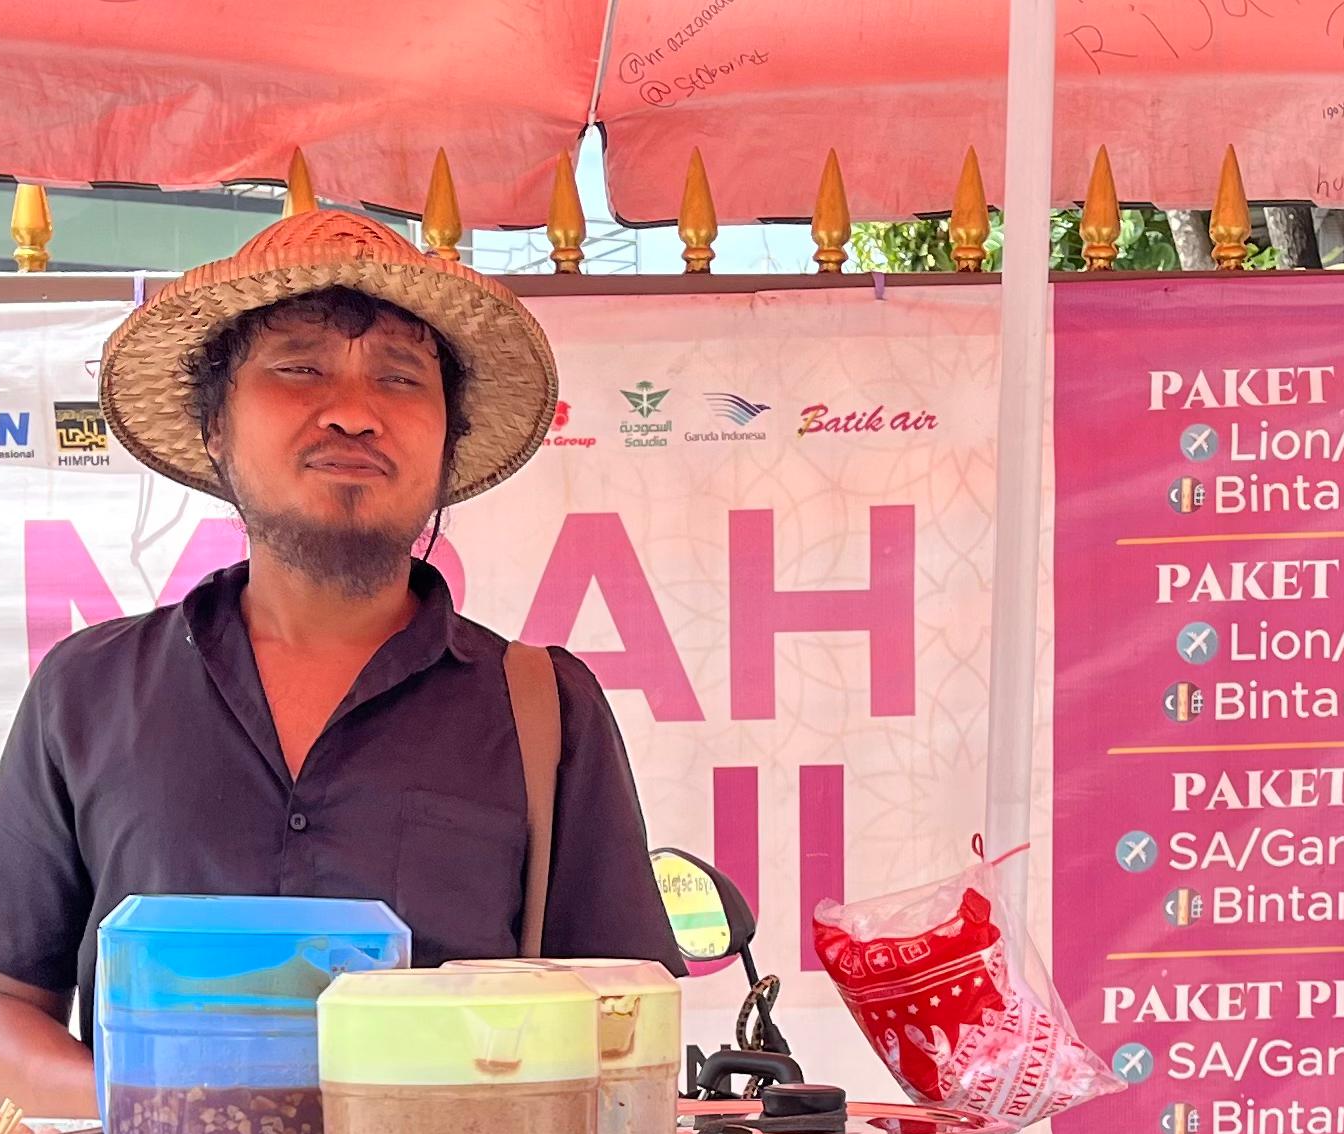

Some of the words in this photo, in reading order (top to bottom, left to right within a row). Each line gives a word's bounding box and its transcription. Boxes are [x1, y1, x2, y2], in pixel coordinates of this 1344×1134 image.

[1147, 365, 1335, 412] PAKET
[799, 403, 884, 435] Batik
[553, 437, 597, 448] Group
[624, 434, 668, 447] Saudia
[684, 432, 719, 442] Garuda
[721, 431, 767, 441] Indonesia
[58, 456, 110, 466] HIMPUH
[1156, 558, 1340, 604] PAKET
[1100, 978, 1283, 1025] PAKET
